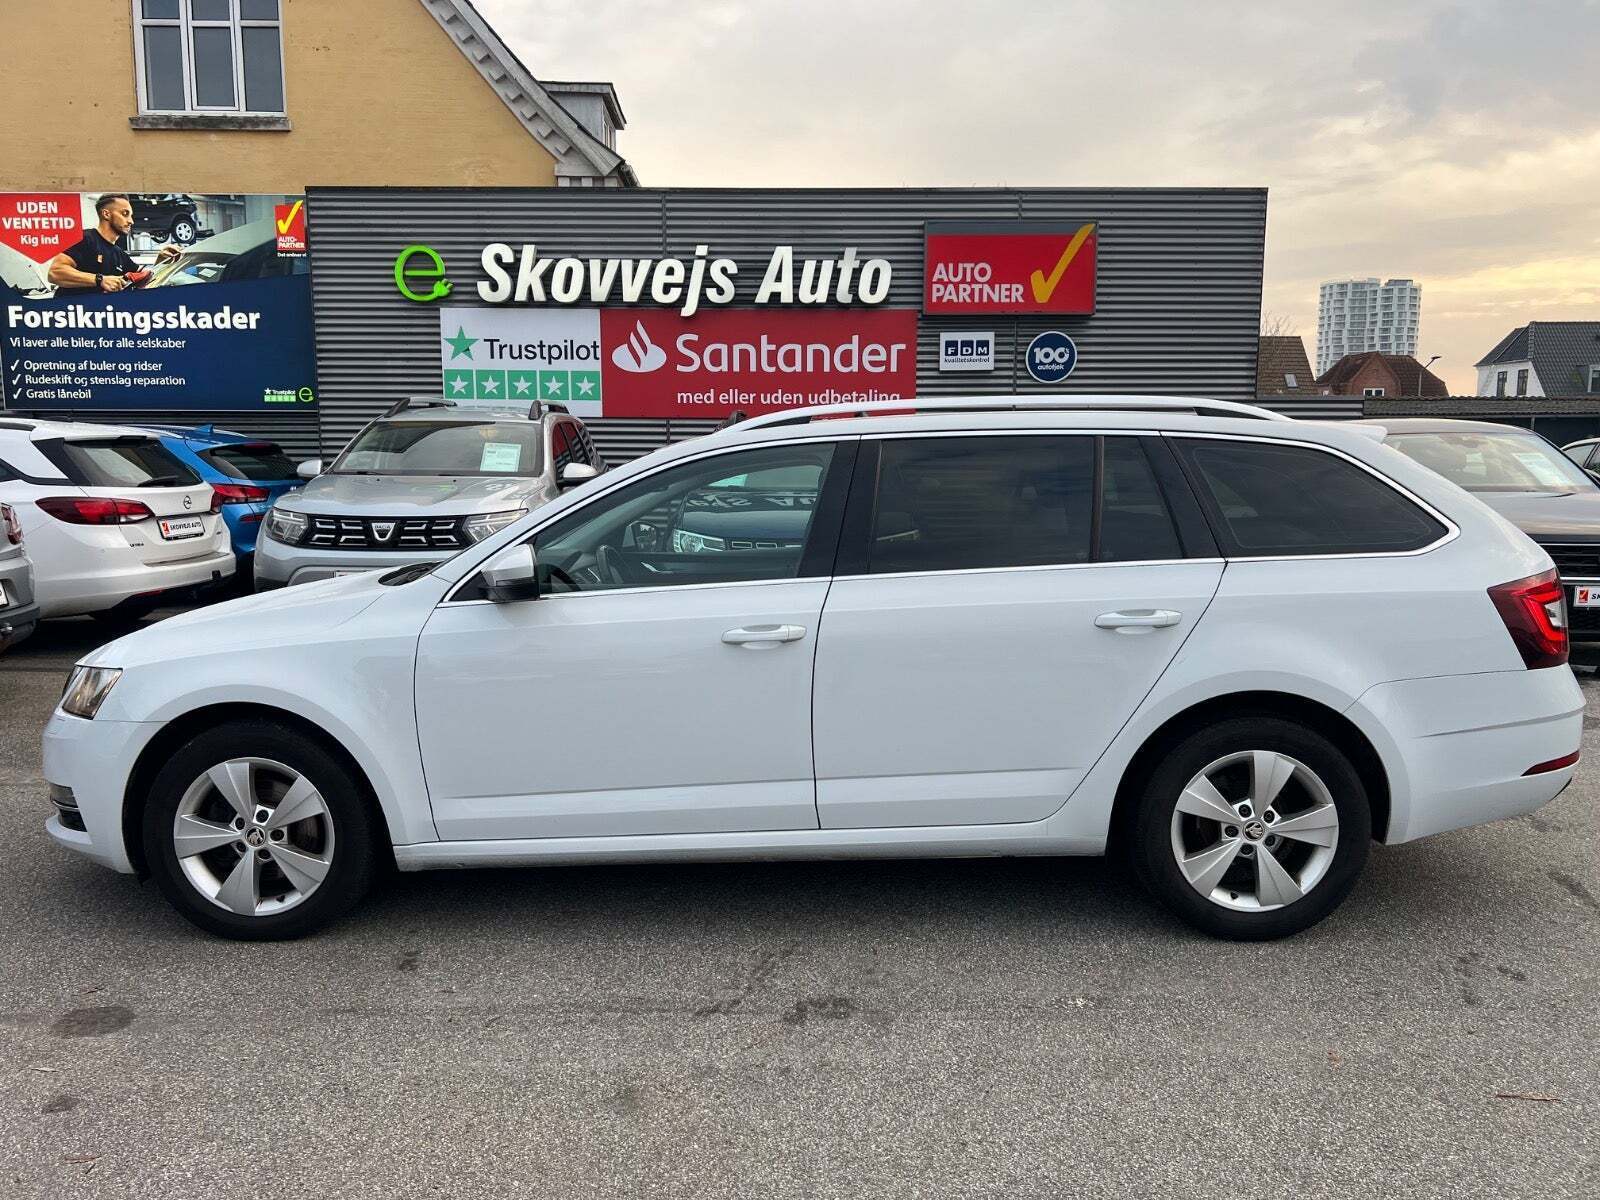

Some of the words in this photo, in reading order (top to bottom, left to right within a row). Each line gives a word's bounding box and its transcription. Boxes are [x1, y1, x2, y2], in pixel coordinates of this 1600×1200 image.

[16, 201, 58, 214] UDEN
[2, 217, 75, 230] VENTETID
[20, 234, 39, 247] Kig
[41, 234, 59, 245] ind
[932, 262, 992, 283] AUTO
[477, 243, 738, 317] Skovvejs
[755, 246, 893, 304] Auto
[931, 283, 1025, 303] PARTNER
[8, 304, 261, 335] Forsikringsskader
[10, 337, 21, 348] Vi
[23, 337, 48, 348] laver
[51, 337, 69, 348] alle
[71, 337, 97, 349] biler,
[99, 338, 113, 348] for
[116, 338, 134, 348] alle
[137, 338, 186, 349] selskaber
[484, 337, 601, 366] Trustpilot
[677, 333, 907, 374] Santander
[23, 360, 76, 373] Opretning
[78, 361, 88, 371] af
[90, 361, 116, 371] buler
[118, 364, 131, 373] og
[134, 361, 162, 372] ridser
[25, 374, 72, 385] Rudeskift
[74, 378, 88, 387] og
[90, 375, 131, 387] stenslag
[134, 375, 186, 387] reparation
[26, 389, 56, 399] Gratis
[58, 388, 91, 399] lånebil
[677, 388, 714, 404] med
[719, 388, 756, 404] eller
[761, 389, 803, 404] uden
